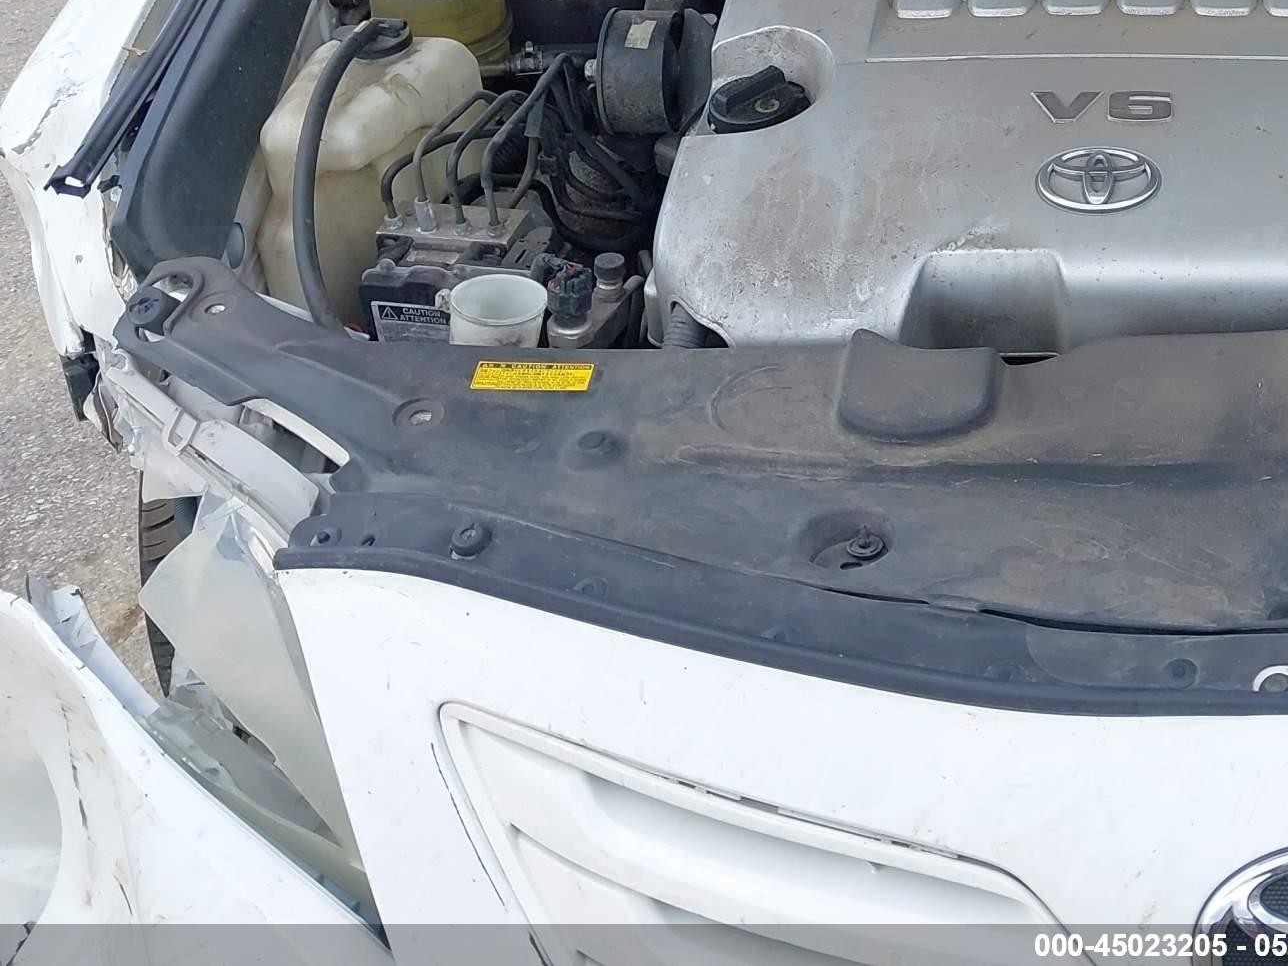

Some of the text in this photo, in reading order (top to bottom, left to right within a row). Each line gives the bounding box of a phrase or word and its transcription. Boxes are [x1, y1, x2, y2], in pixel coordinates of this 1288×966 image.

[1030, 90, 1173, 123] V6
[402, 307, 441, 317] CAUTION
[400, 314, 447, 324] ATTENTION
